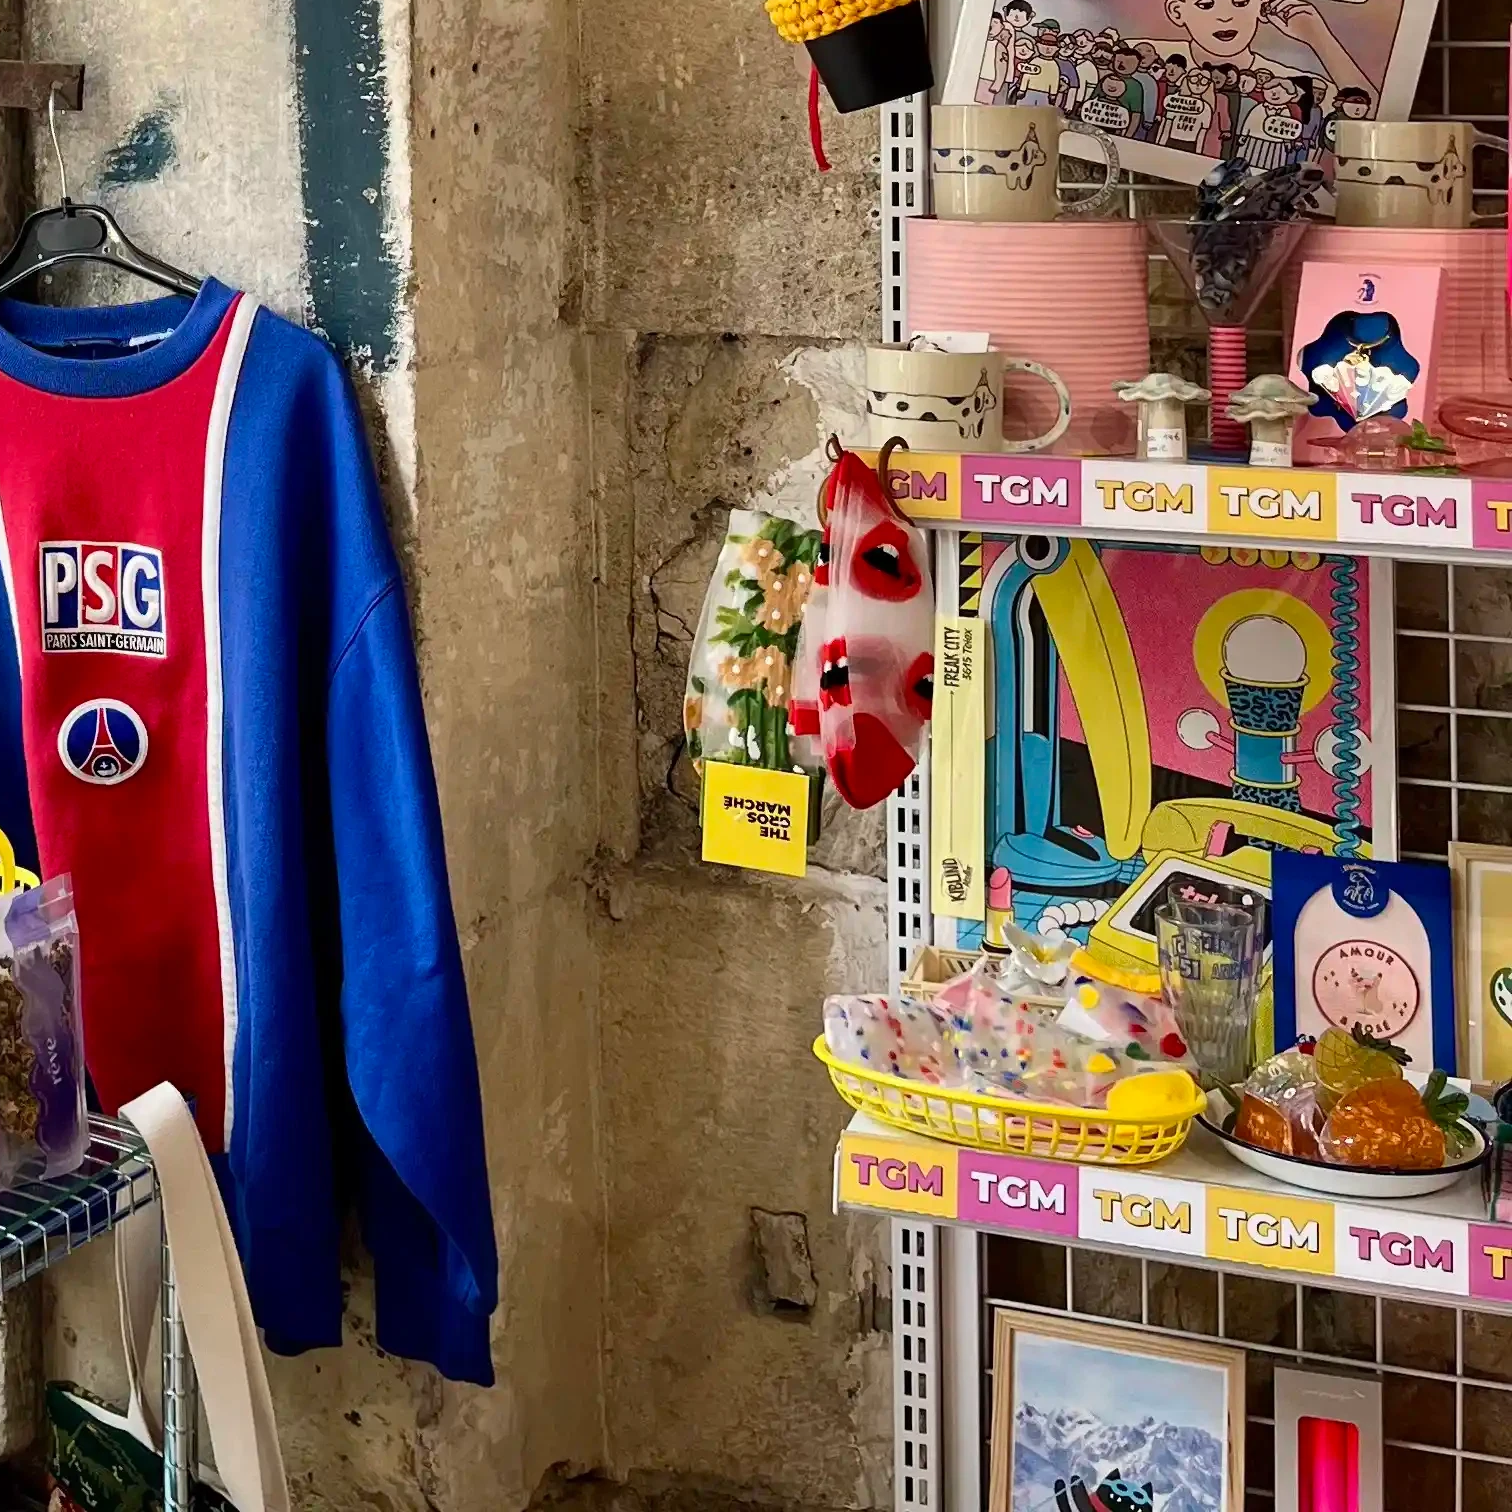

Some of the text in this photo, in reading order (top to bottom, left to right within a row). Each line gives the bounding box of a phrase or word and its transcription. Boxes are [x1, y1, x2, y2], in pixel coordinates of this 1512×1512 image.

[973, 473, 1069, 508] TGM
[1096, 479, 1193, 514] TGM
[1220, 486, 1322, 522] TGM
[1351, 493, 1457, 528] TGM
[45, 550, 160, 629] PSG
[46, 633, 164, 653] PARIS SAINT-GERMAIN
[943, 626, 960, 687] FREAK CITY
[723, 795, 791, 817] MARCHÉ
[746, 811, 791, 829] GROS
[759, 826, 791, 842] THE
[1339, 946, 1395, 966] AMOUR
[45, 1037, 63, 1087] rêve
[850, 1153, 943, 1195] TGM
[970, 1170, 1066, 1215] TGM
[1093, 1190, 1192, 1235] TGM
[1218, 1207, 1320, 1255] TGM
[1348, 1226, 1454, 1275] TGM
